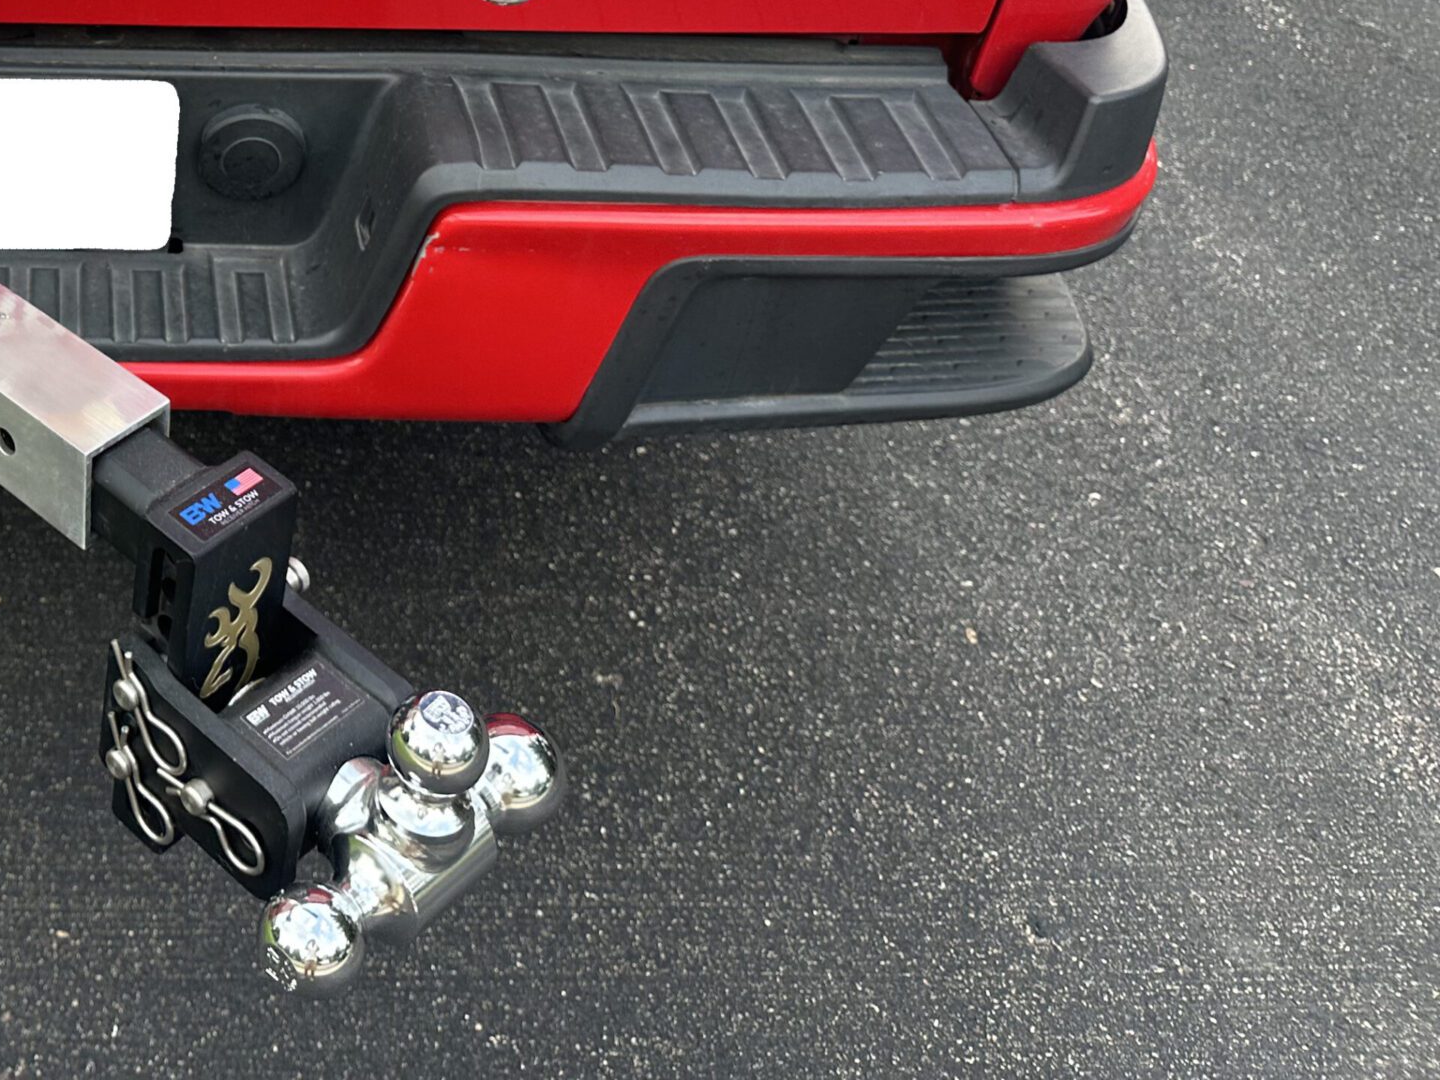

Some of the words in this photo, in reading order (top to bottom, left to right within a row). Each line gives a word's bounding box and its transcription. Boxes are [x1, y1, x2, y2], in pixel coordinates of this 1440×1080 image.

[208, 508, 230, 525] TOW
[228, 504, 237, 513] &
[234, 489, 260, 508] STOW
[268, 688, 291, 707] TOW
[286, 683, 297, 694] &
[293, 667, 318, 688] STOW
